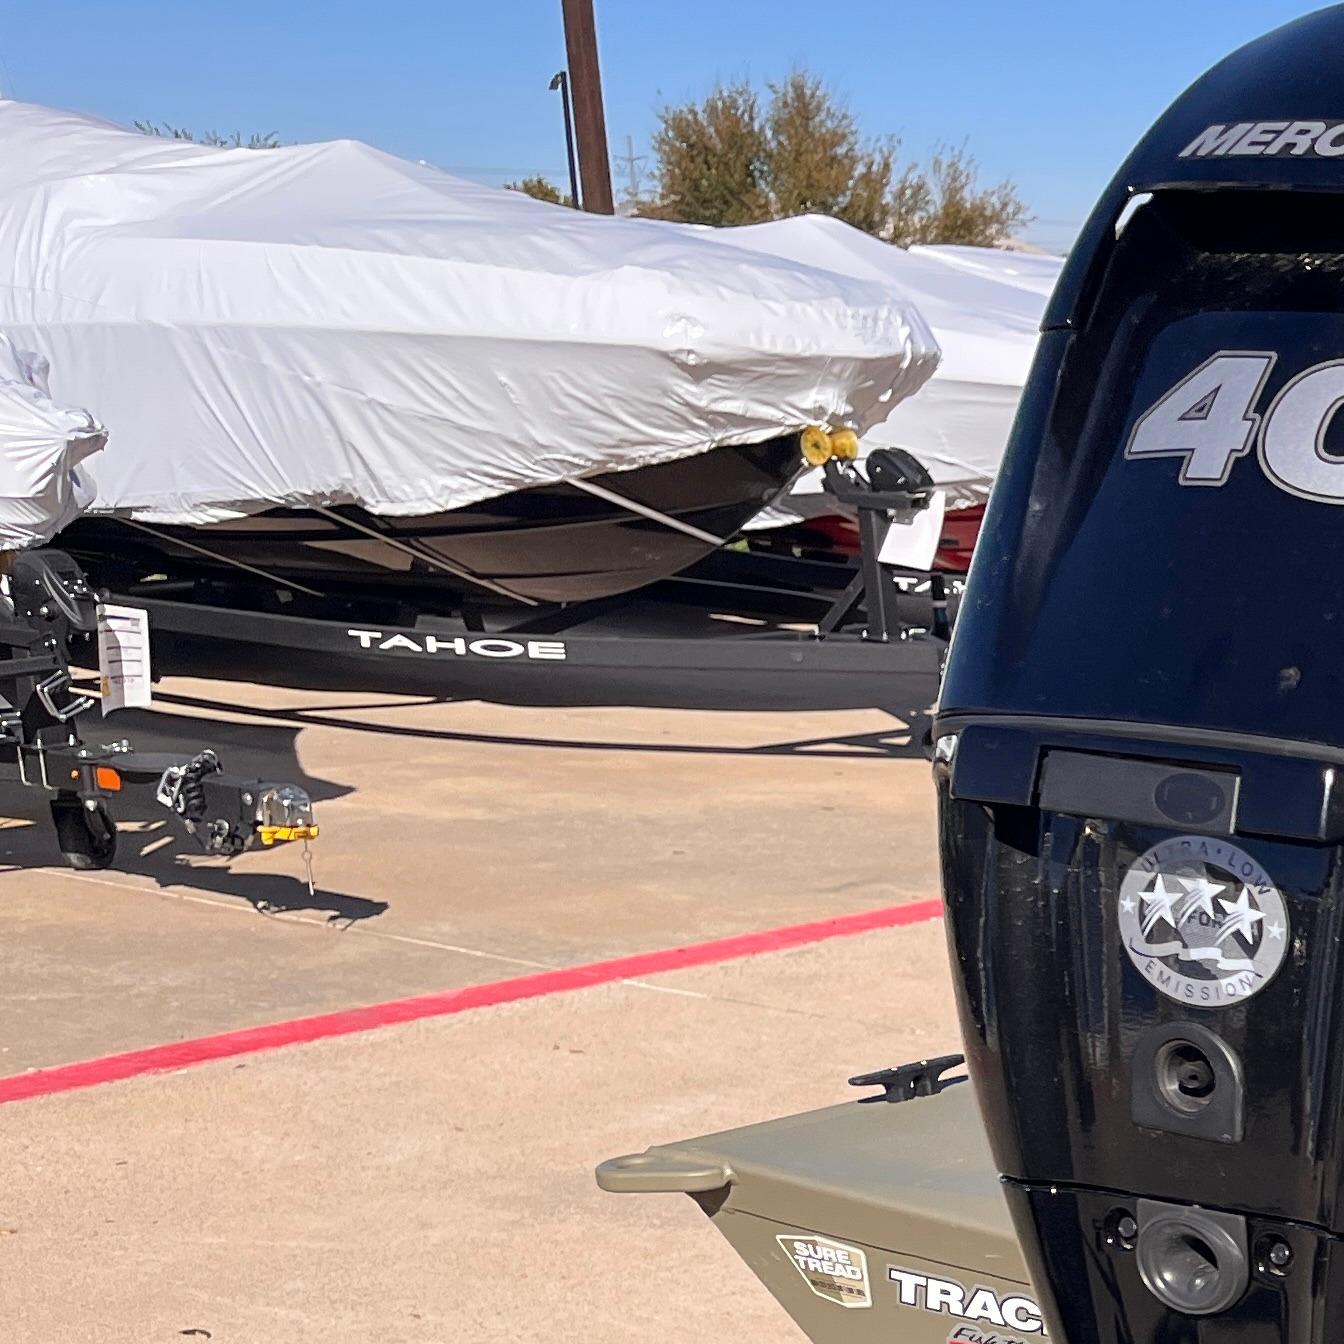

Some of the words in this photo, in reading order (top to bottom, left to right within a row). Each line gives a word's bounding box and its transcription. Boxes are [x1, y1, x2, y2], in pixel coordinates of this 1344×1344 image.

[348, 629, 566, 661] TAHOE
[1143, 957, 1260, 1002] EMISSION
[793, 1240, 852, 1265] SURE
[793, 1254, 863, 1281] TREAD
[889, 1268, 1050, 1337] TRAC
